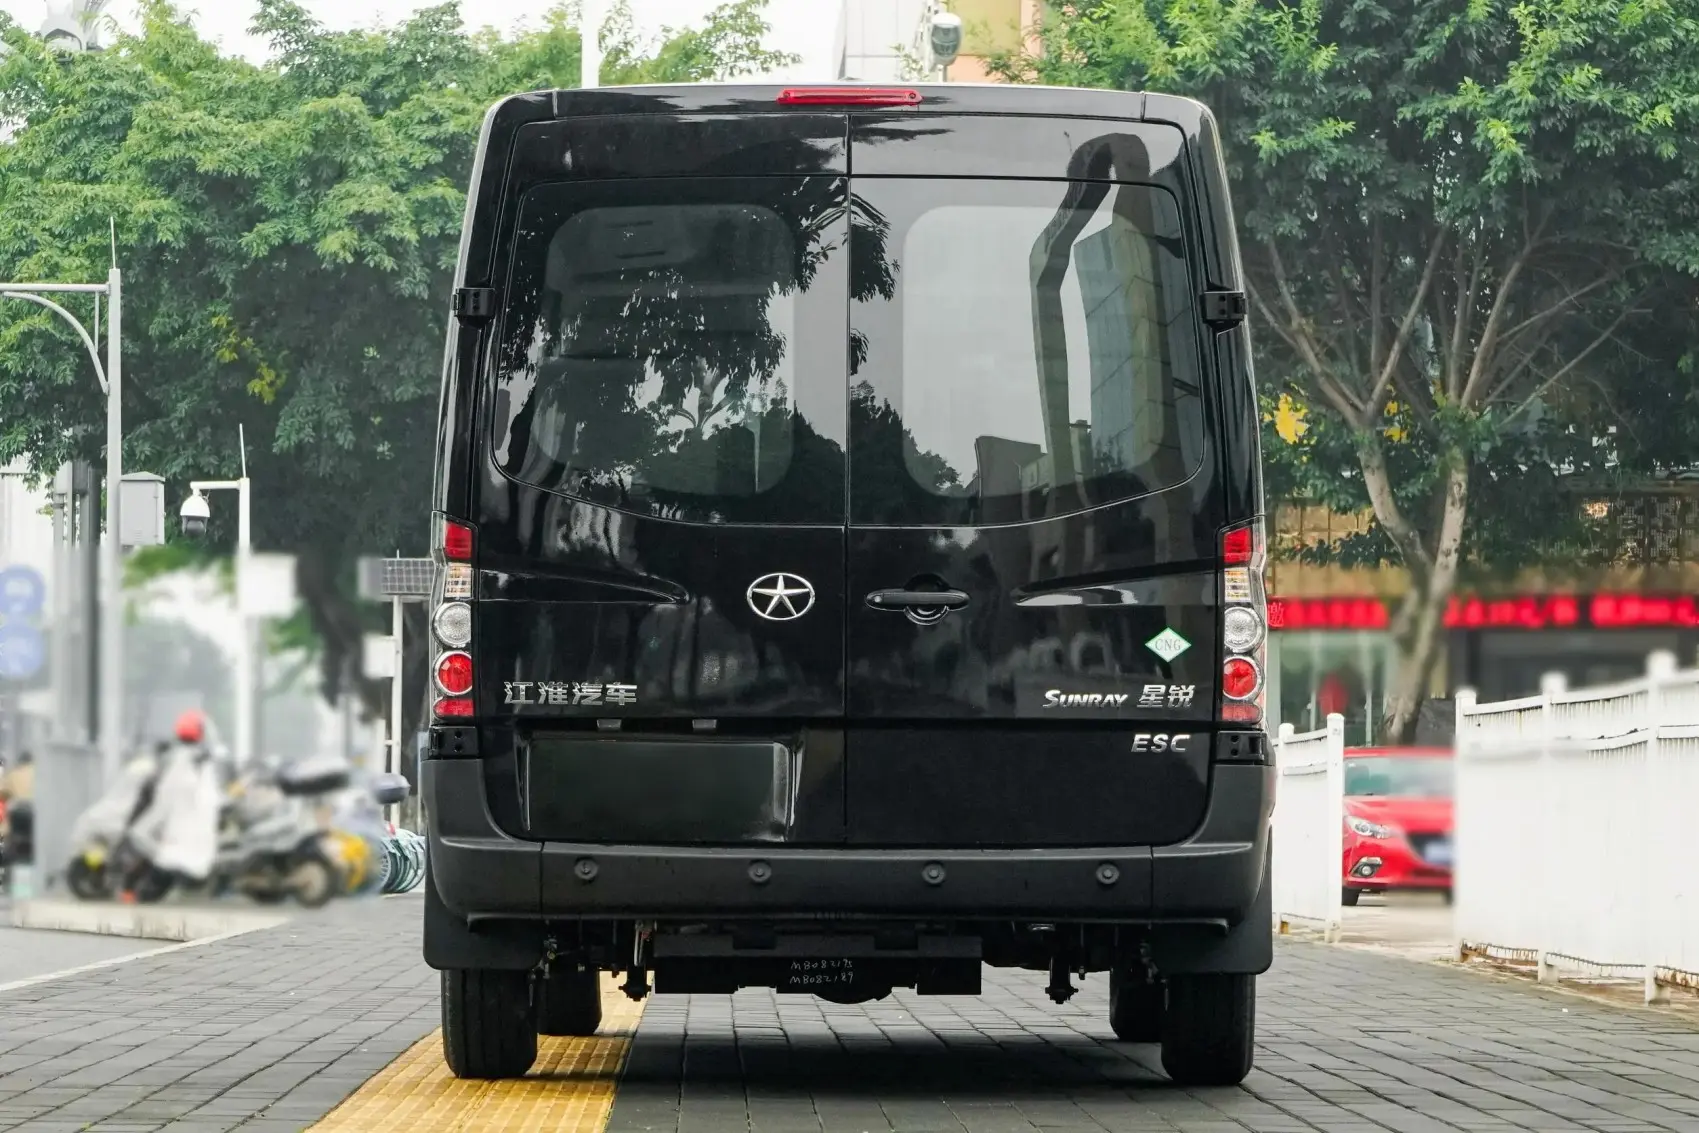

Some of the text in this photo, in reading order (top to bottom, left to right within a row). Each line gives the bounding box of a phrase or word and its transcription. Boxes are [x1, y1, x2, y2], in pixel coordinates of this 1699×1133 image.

[1154, 638, 1181, 651] CNG
[503, 681, 638, 706] 江淮汽车
[1042, 684, 1196, 709] SUNRAY 星锐
[1130, 733, 1191, 753] ESC
